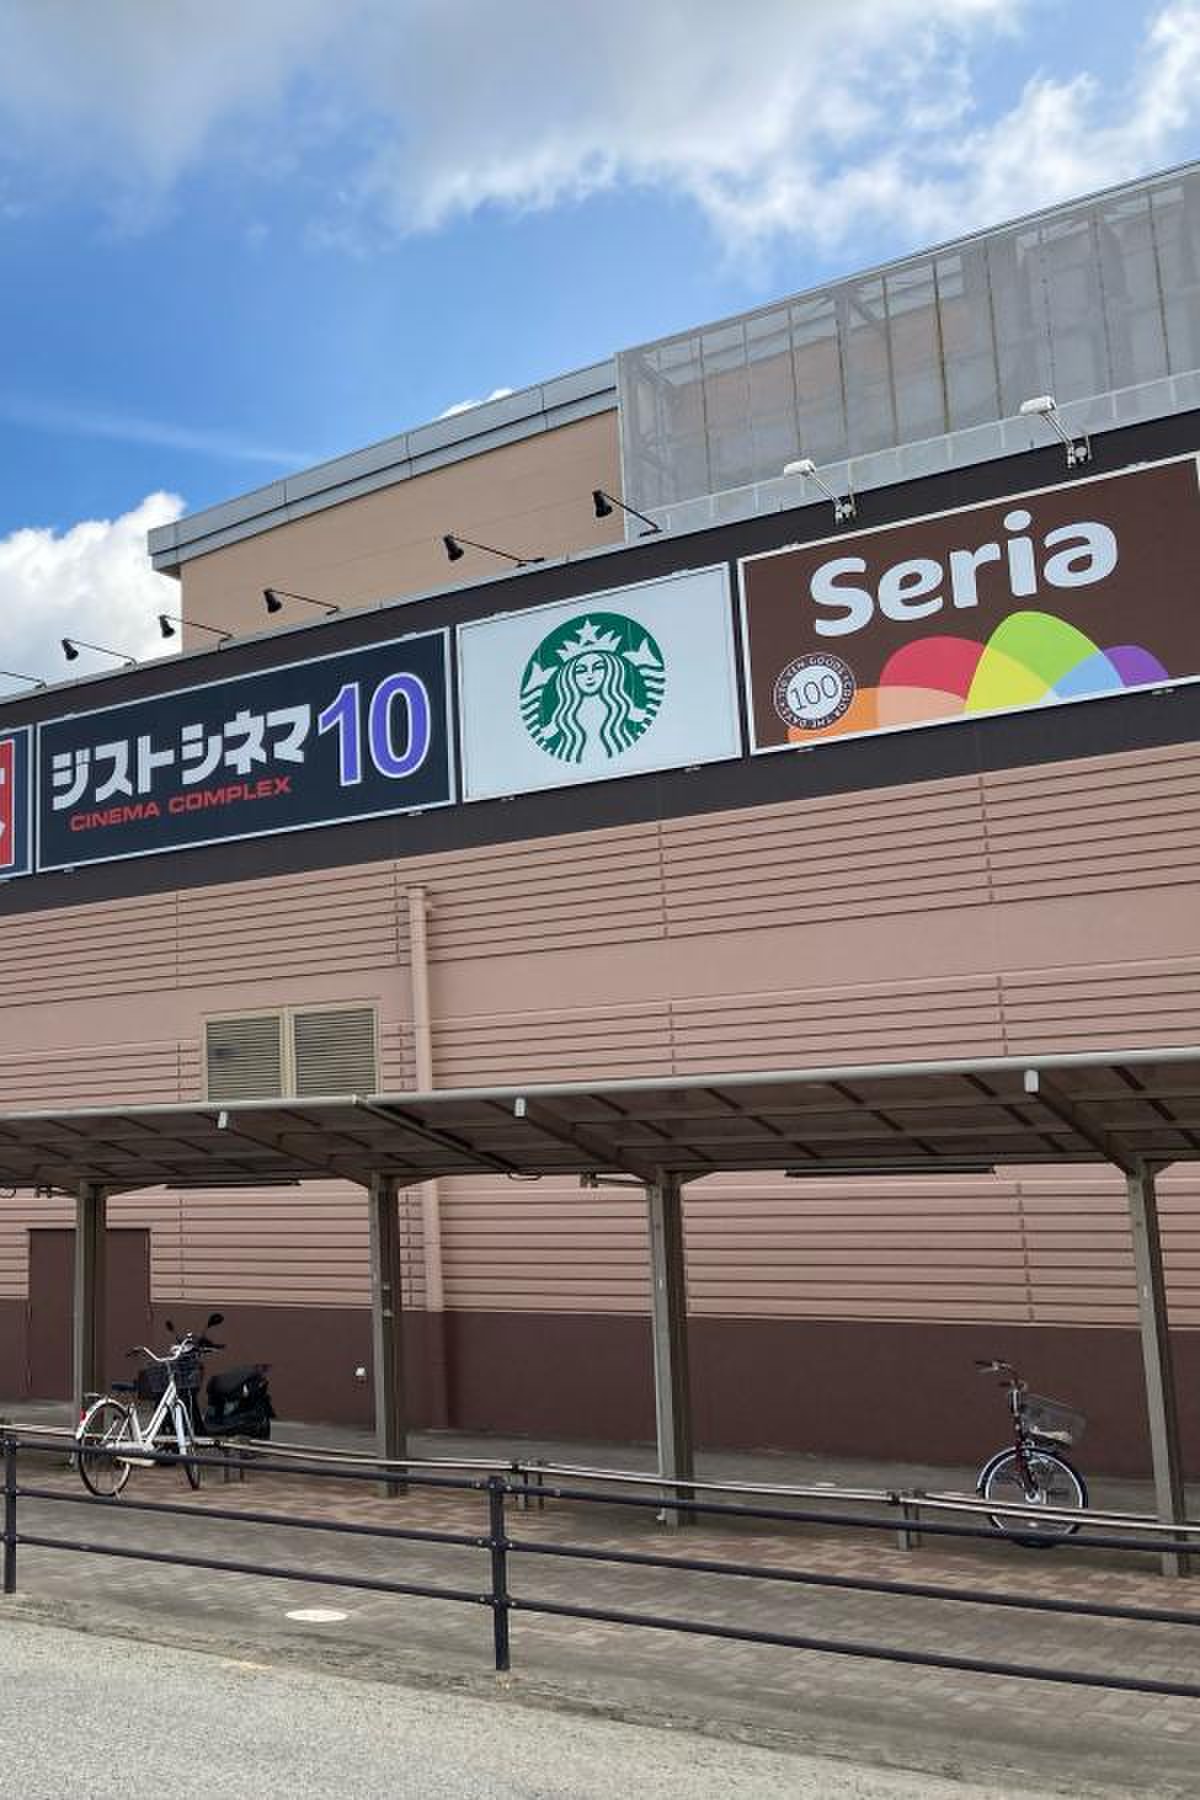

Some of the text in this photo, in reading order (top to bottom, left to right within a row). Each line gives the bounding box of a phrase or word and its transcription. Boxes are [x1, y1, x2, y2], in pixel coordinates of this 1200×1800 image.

[809, 510, 1119, 637] Seria
[790, 674, 839, 711] 100
[69, 776, 293, 833] CINEMA COMPLEX
